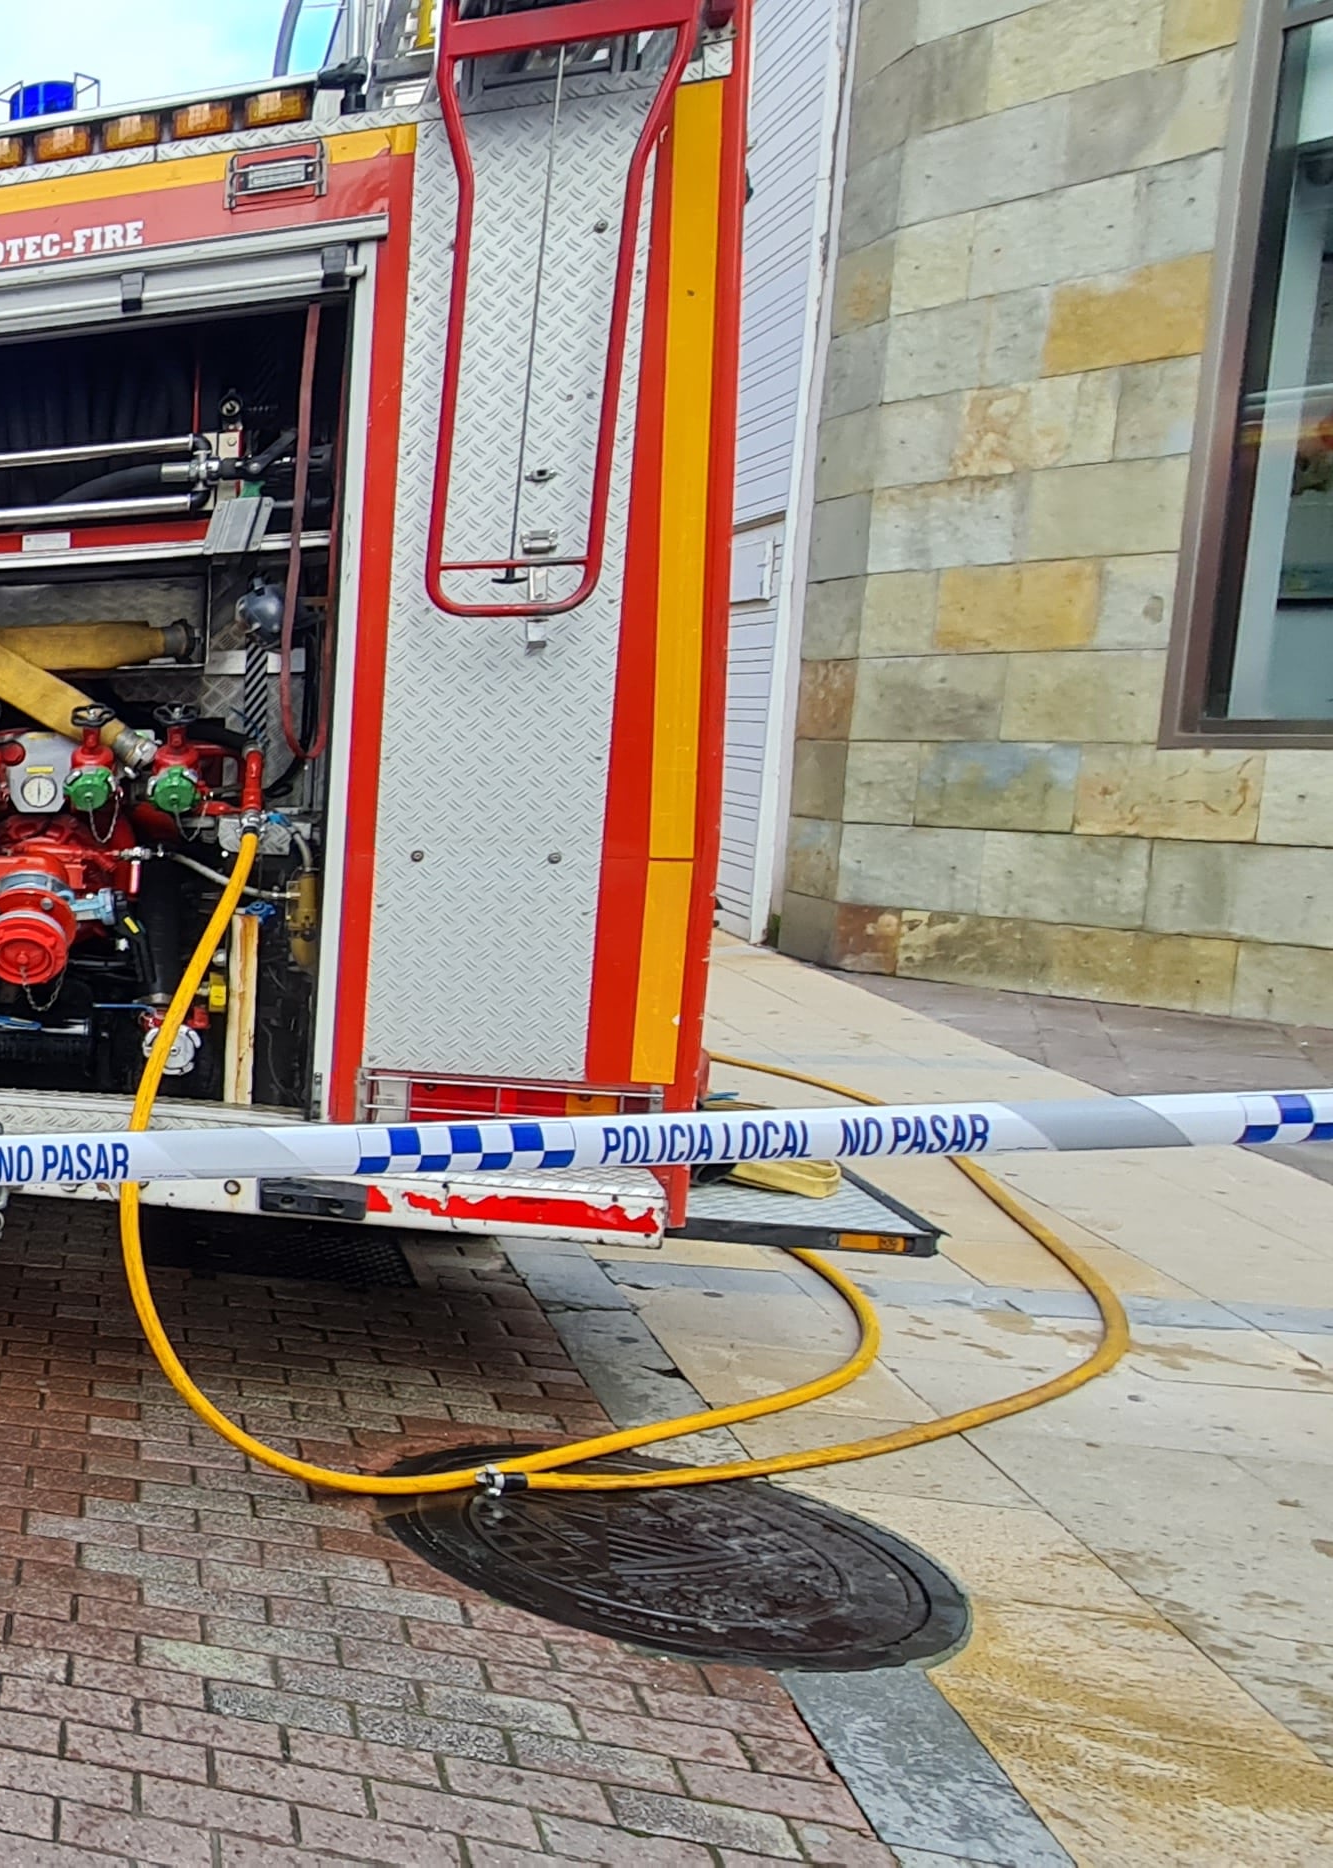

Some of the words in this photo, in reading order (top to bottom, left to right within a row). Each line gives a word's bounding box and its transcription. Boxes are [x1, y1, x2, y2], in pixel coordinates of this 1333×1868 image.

[600, 1123, 713, 1164] POLICIA
[721, 1120, 812, 1160] LOCAL
[836, 1117, 882, 1157] NO
[887, 1113, 991, 1155] PASAR
[41, 1142, 129, 1181] PASAR
